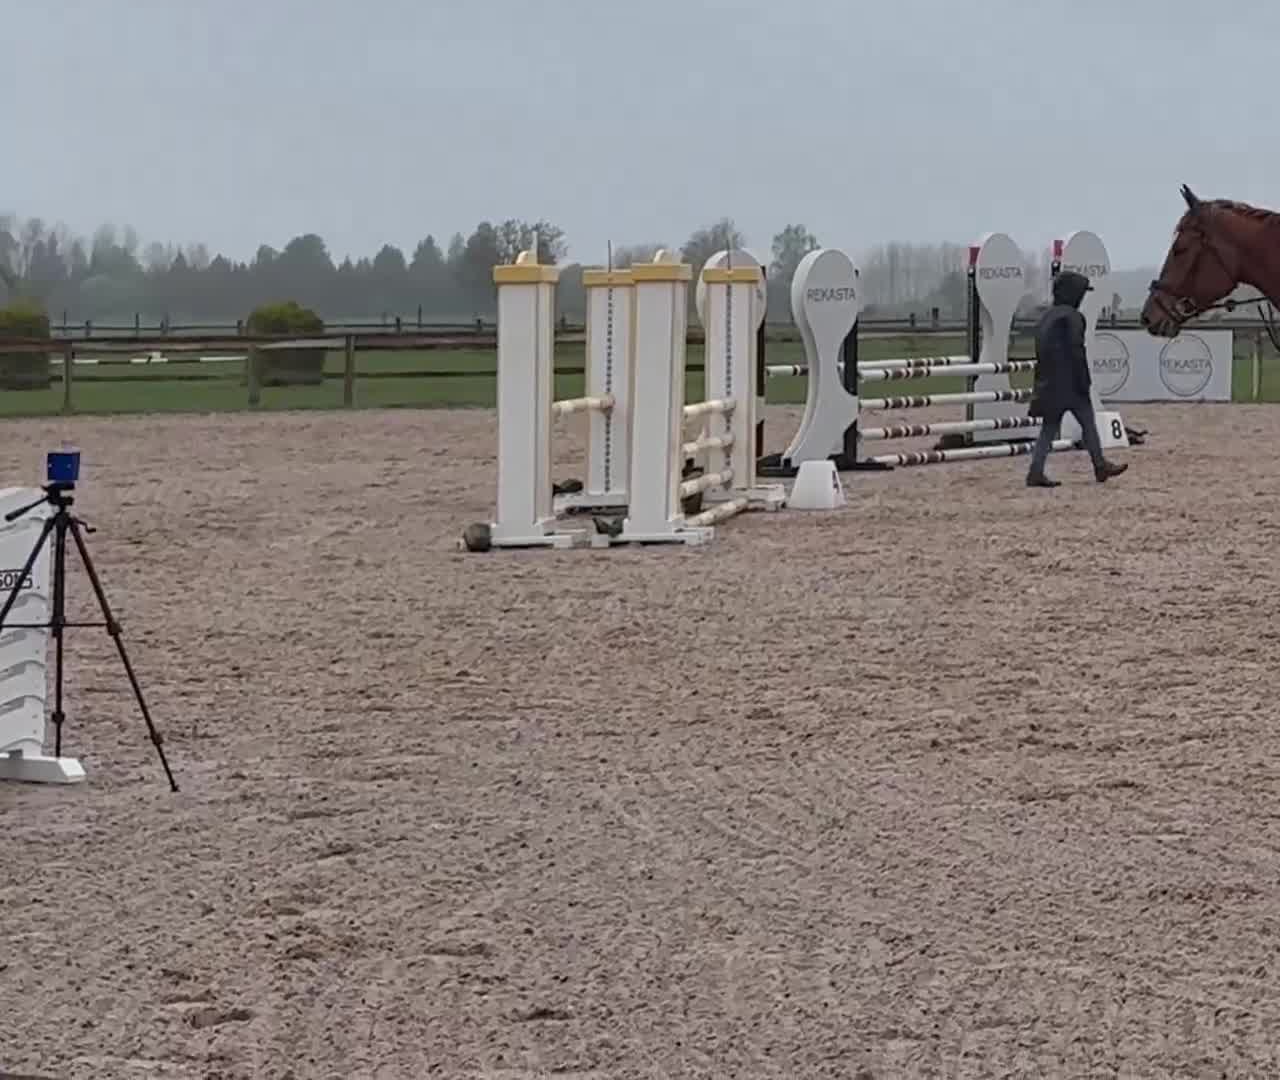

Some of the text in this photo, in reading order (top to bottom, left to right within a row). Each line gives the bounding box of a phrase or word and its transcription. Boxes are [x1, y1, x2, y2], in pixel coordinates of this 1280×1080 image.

[807, 287, 856, 302] REKASTA
[1092, 359, 1129, 370] KASTA
[1111, 418, 1122, 439] 8
